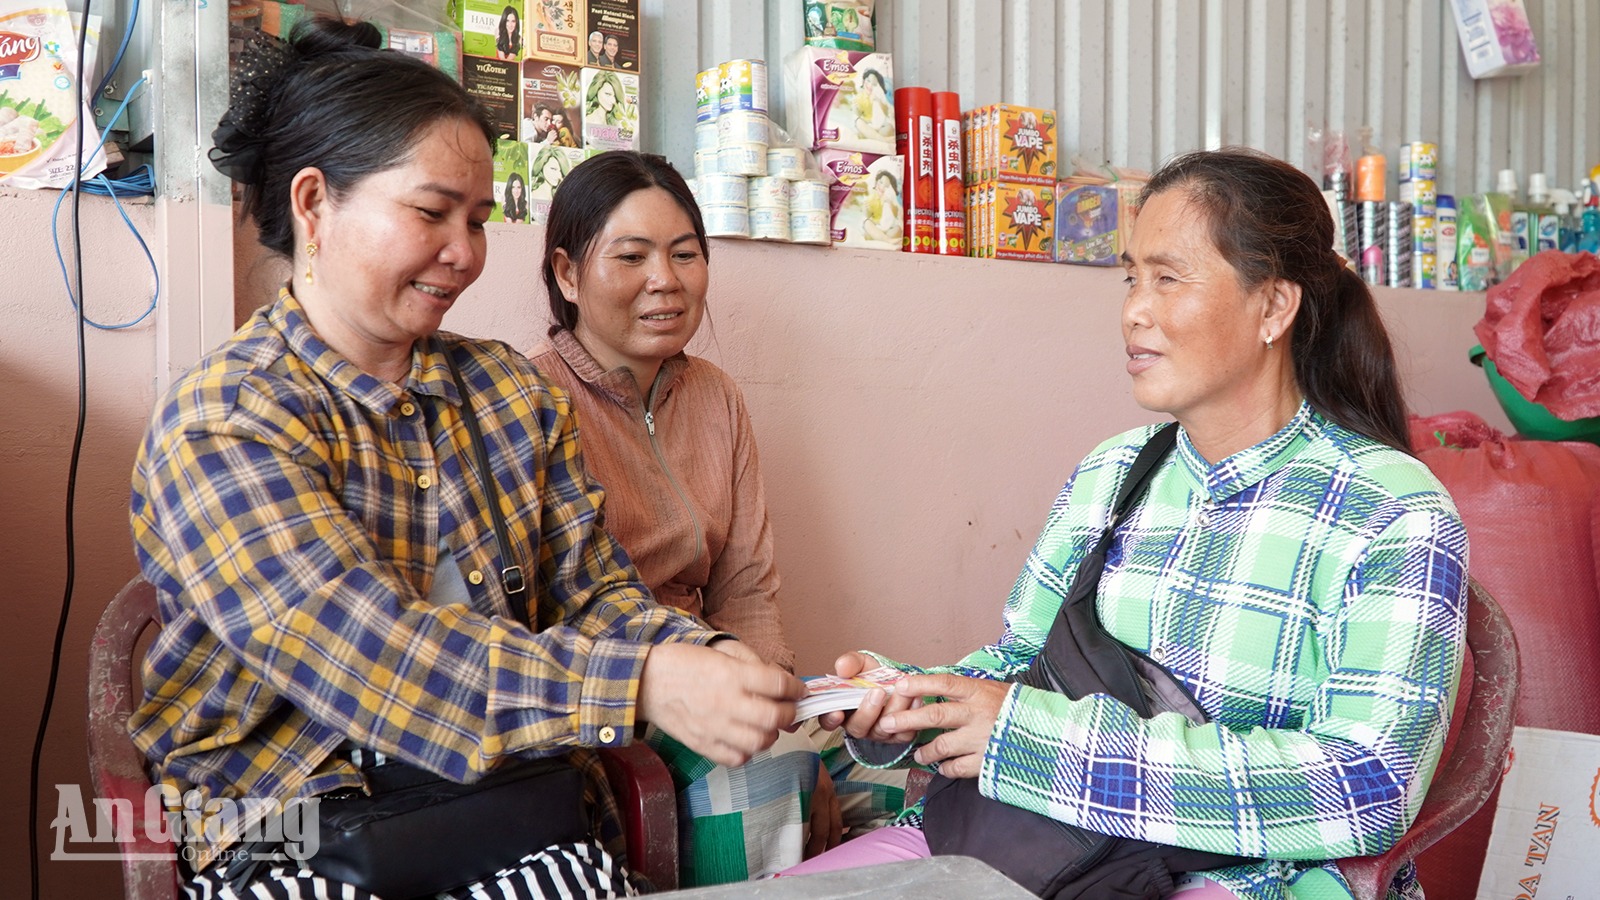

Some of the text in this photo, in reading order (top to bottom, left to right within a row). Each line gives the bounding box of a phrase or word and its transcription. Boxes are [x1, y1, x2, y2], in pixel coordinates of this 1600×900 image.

[471, 15, 495, 26] HAIR
[0, 36, 41, 62] áng
[1018, 128, 1040, 137] JUMBO
[1014, 134, 1043, 150] VAPE
[948, 140, 960, 174] 杀虫剂
[1016, 205, 1038, 214] JUMBO
[1013, 211, 1042, 226] VAPE
[1524, 802, 1560, 867] TAN
